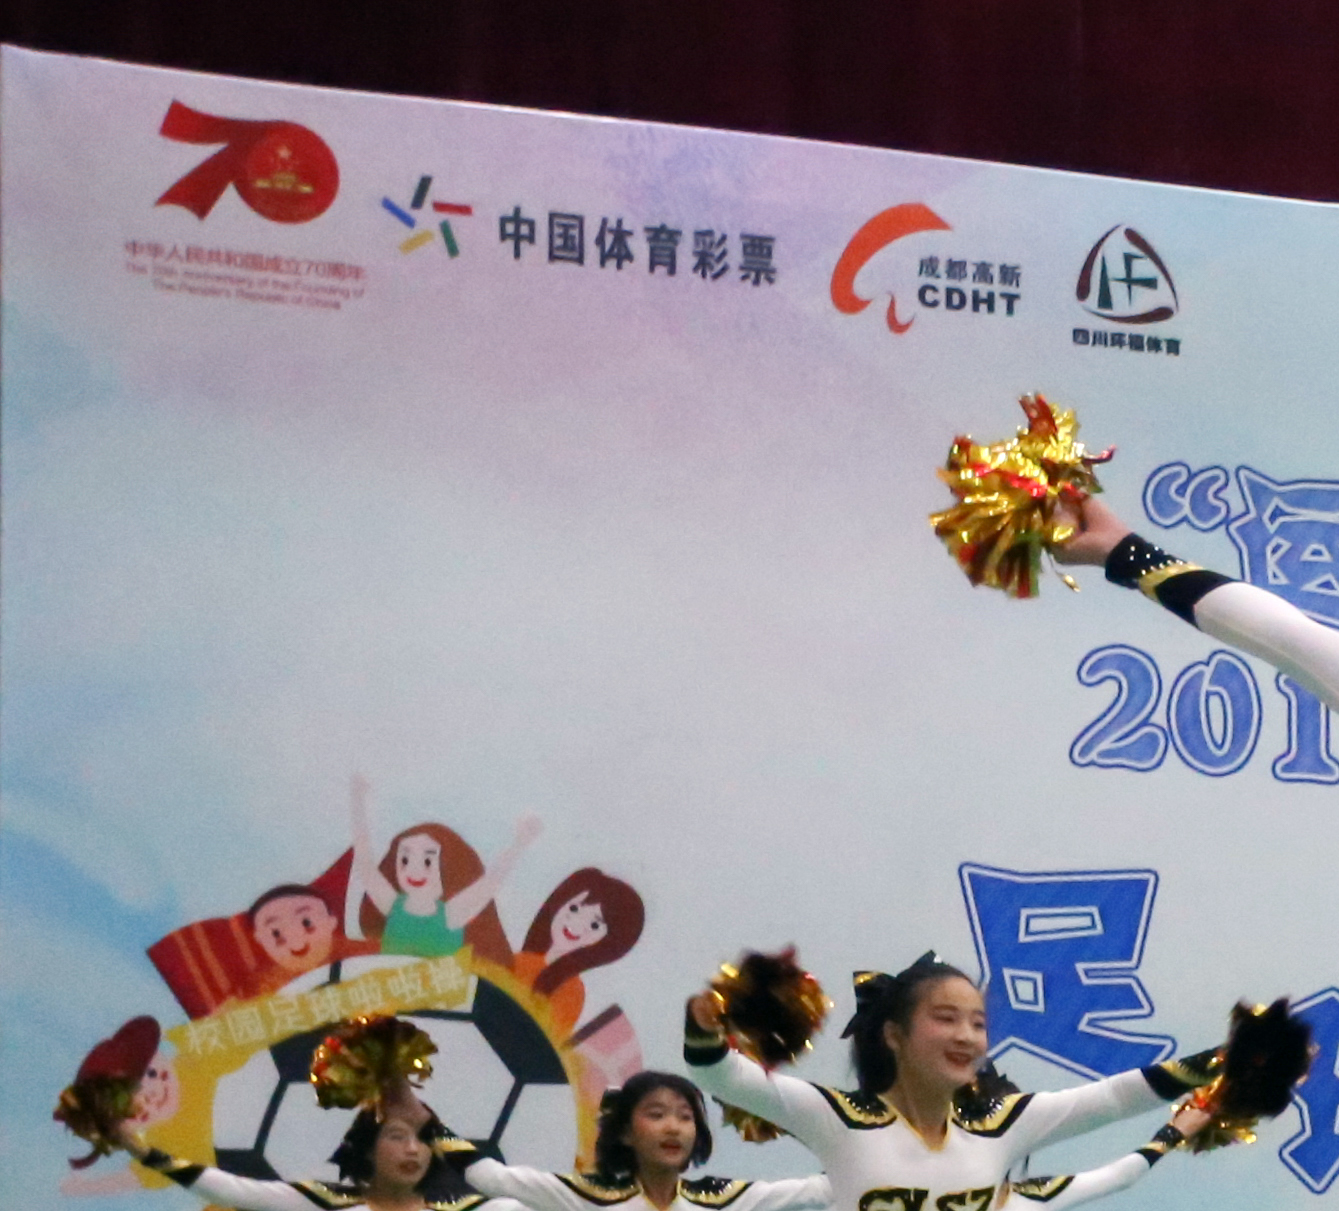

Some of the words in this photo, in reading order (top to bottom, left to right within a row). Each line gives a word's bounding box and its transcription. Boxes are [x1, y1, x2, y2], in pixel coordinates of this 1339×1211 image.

[499, 205, 777, 286] 中国体育彩票
[918, 256, 1021, 288] 成都高新
[918, 283, 1021, 317] CDHT
